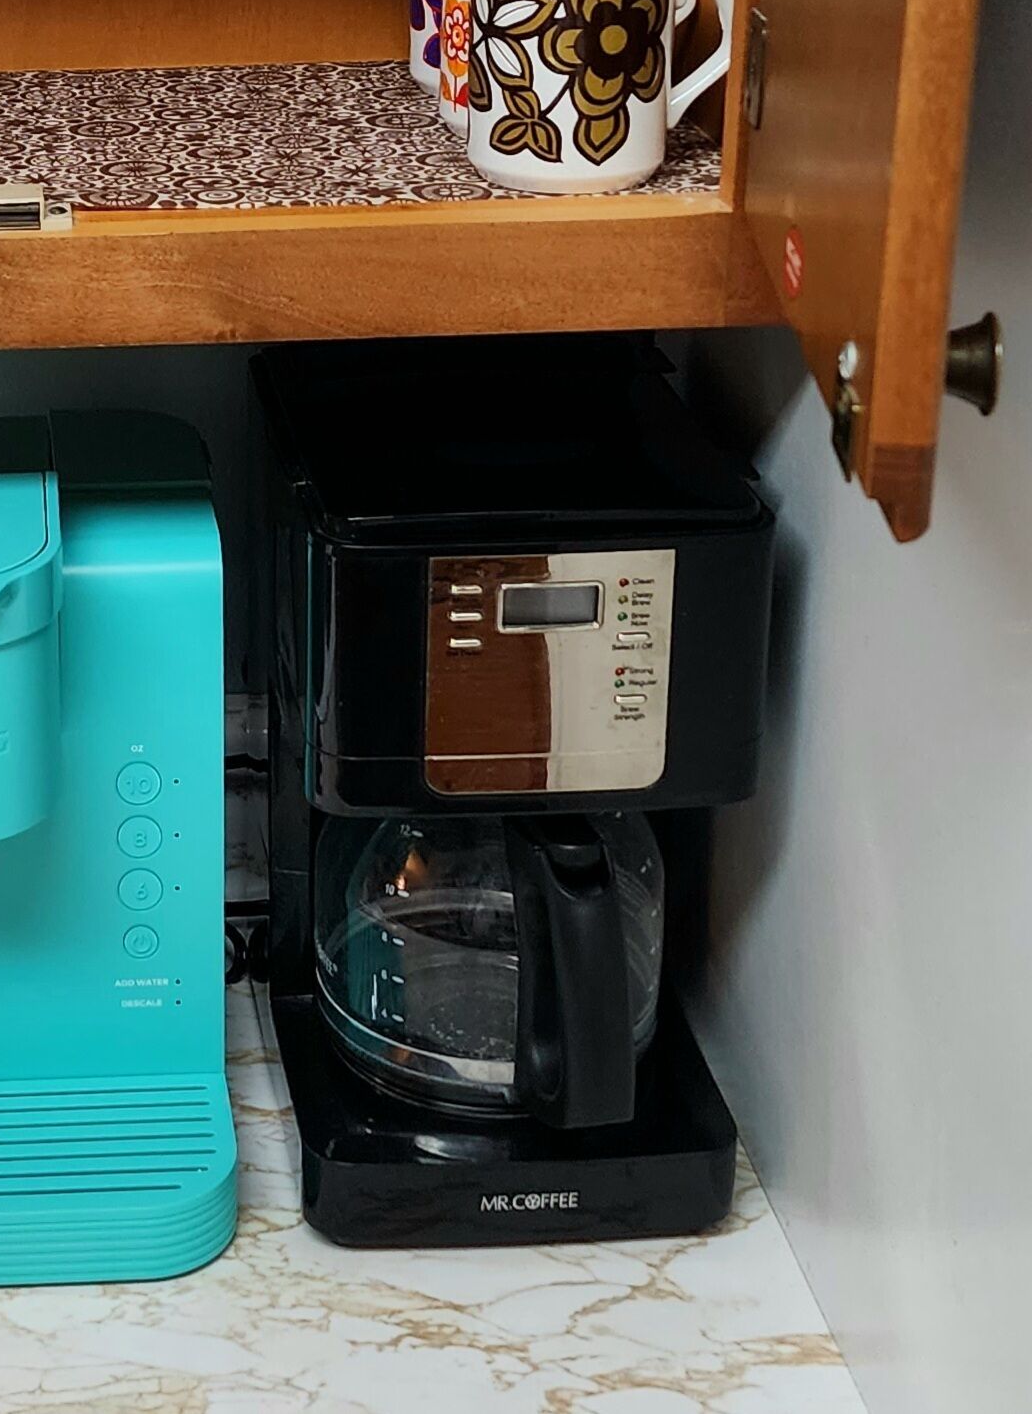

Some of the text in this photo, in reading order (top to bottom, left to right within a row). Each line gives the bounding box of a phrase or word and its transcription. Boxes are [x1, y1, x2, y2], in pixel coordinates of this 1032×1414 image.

[385, 884, 395, 896] 10
[136, 977, 169, 987] WATER
[121, 998, 163, 1008] DESCALE
